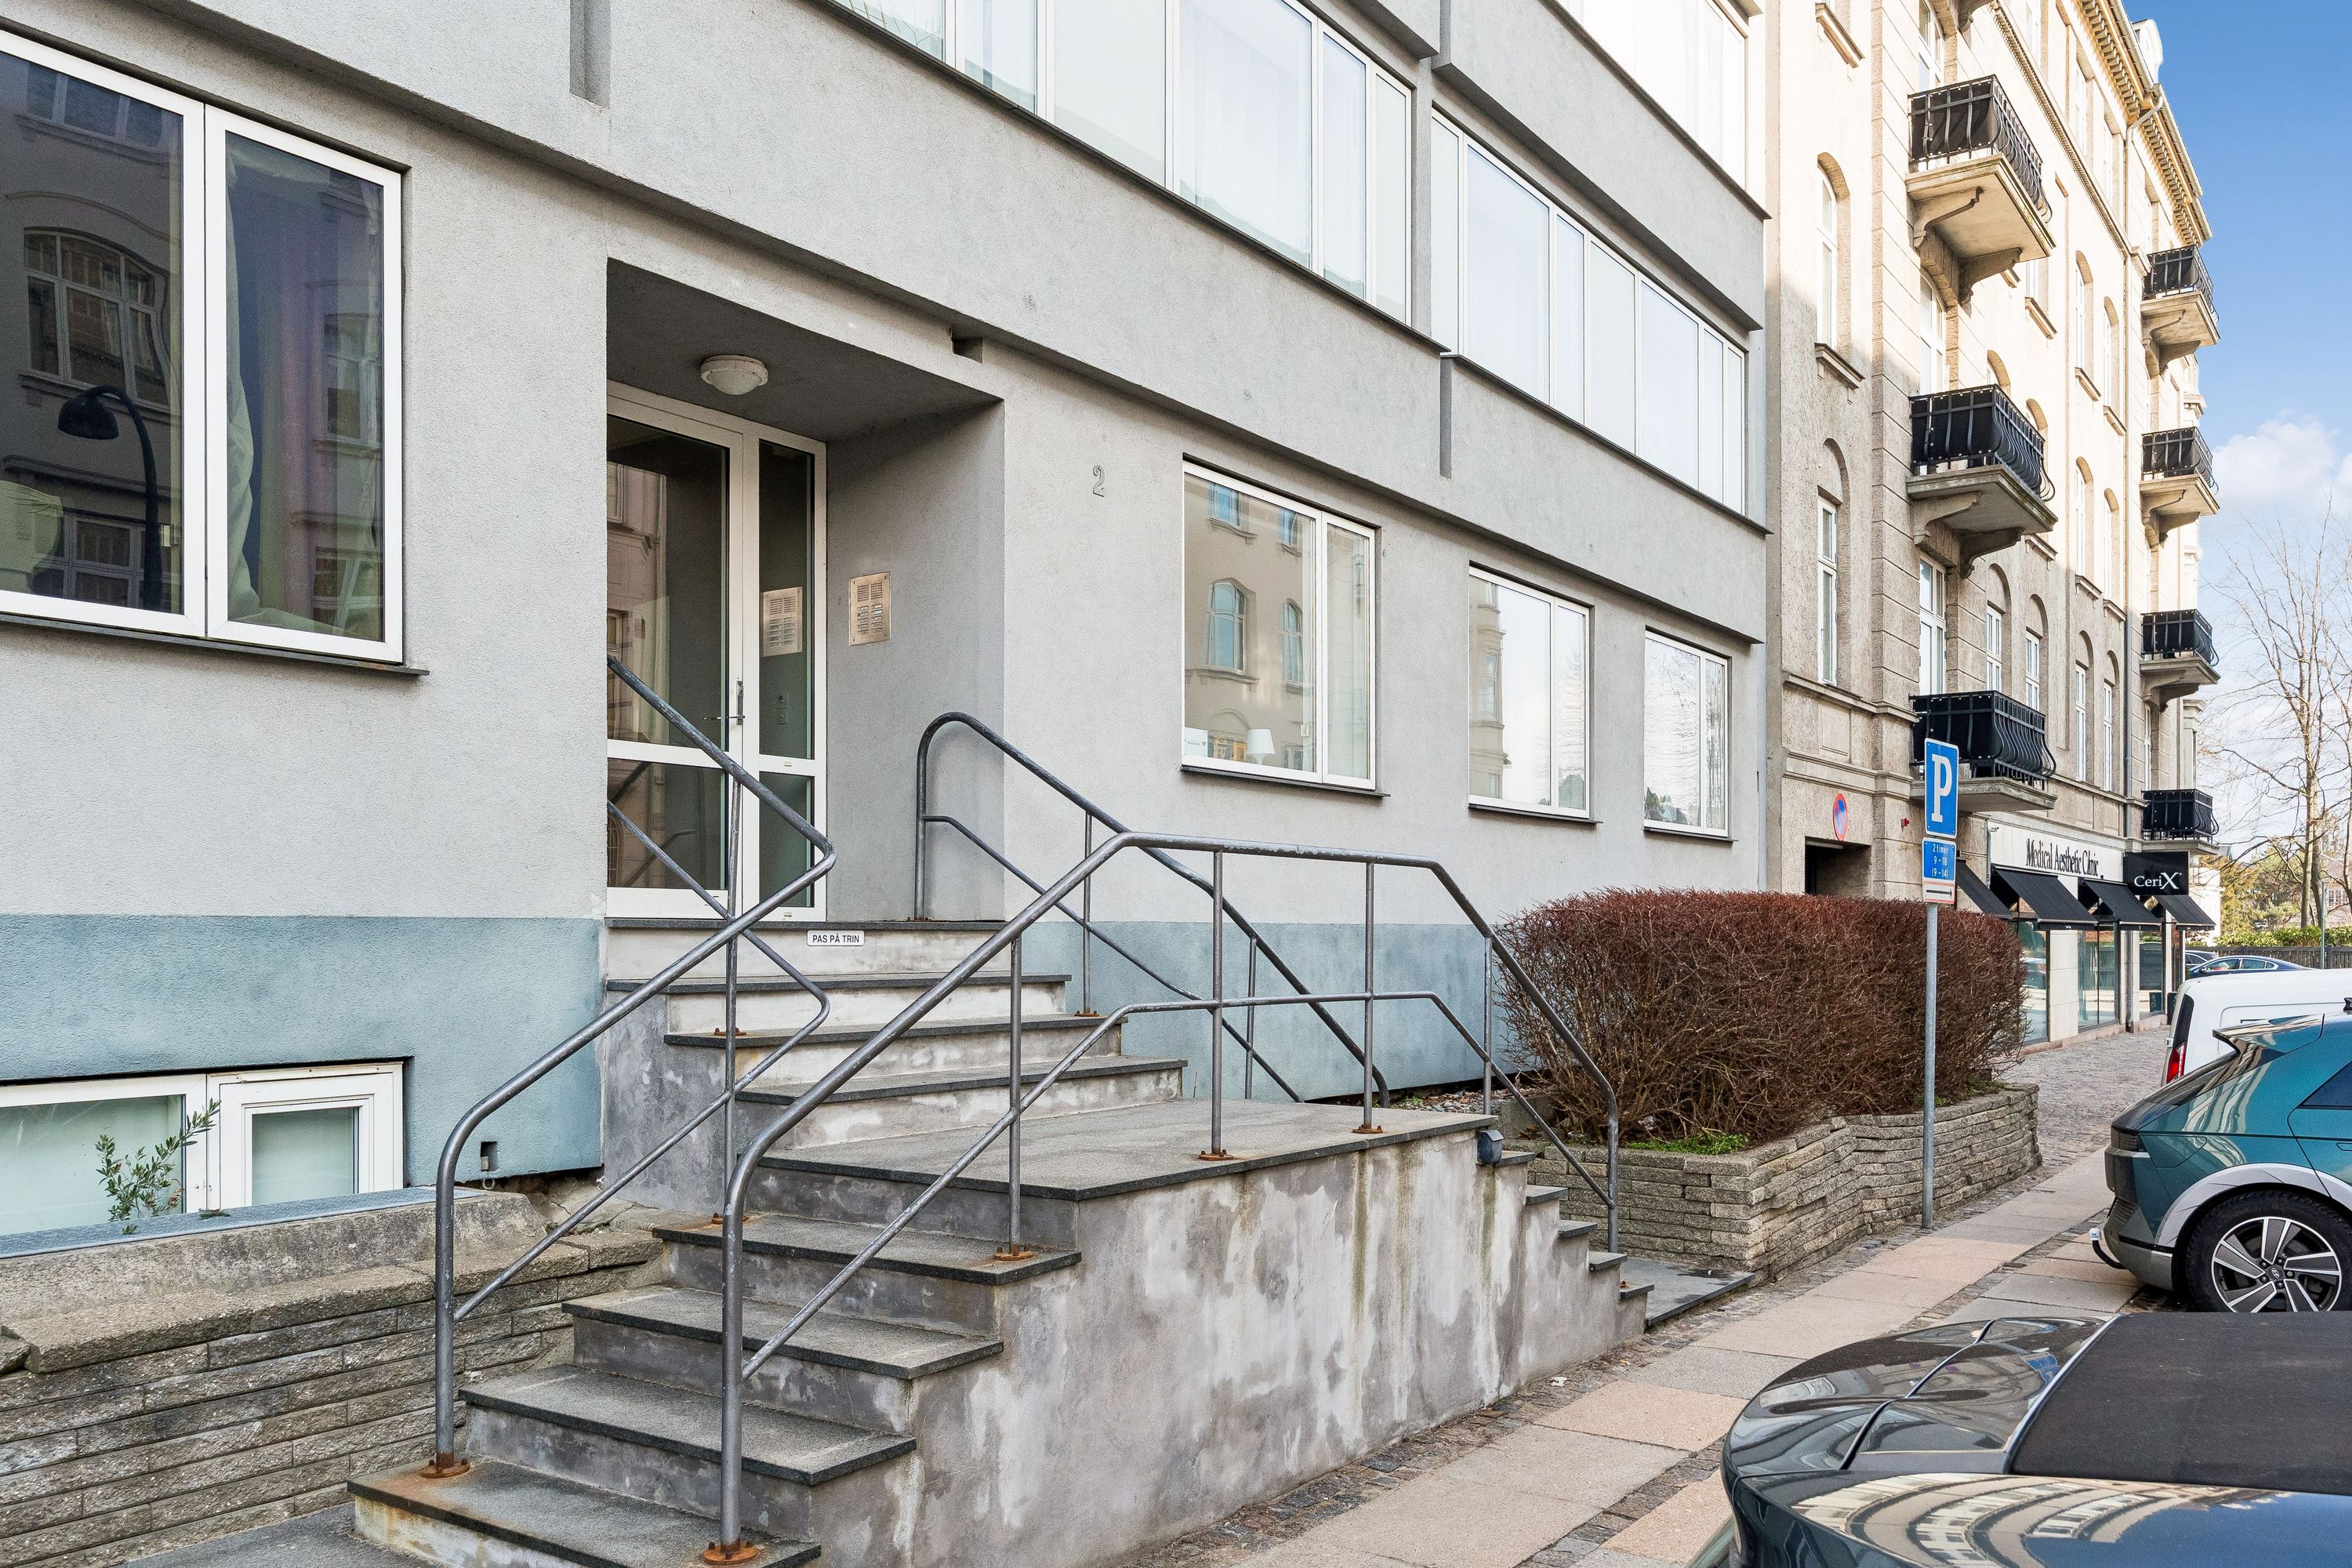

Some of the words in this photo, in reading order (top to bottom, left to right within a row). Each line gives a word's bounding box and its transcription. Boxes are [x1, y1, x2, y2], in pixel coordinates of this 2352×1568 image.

[1093, 465, 1105, 497] 2
[1931, 753, 1952, 823] P
[1933, 843, 1936, 852] 2
[1936, 844, 1948, 855] timer
[2026, 838, 2053, 869] Medical
[2054, 844, 2081, 874] Aesthetic
[2082, 850, 2099, 877] Clinic
[2134, 872, 2180, 890] CeriX
[812, 935, 828, 943] PAS
[829, 932, 840, 943] PÅ
[842, 935, 859, 943] TRIN
